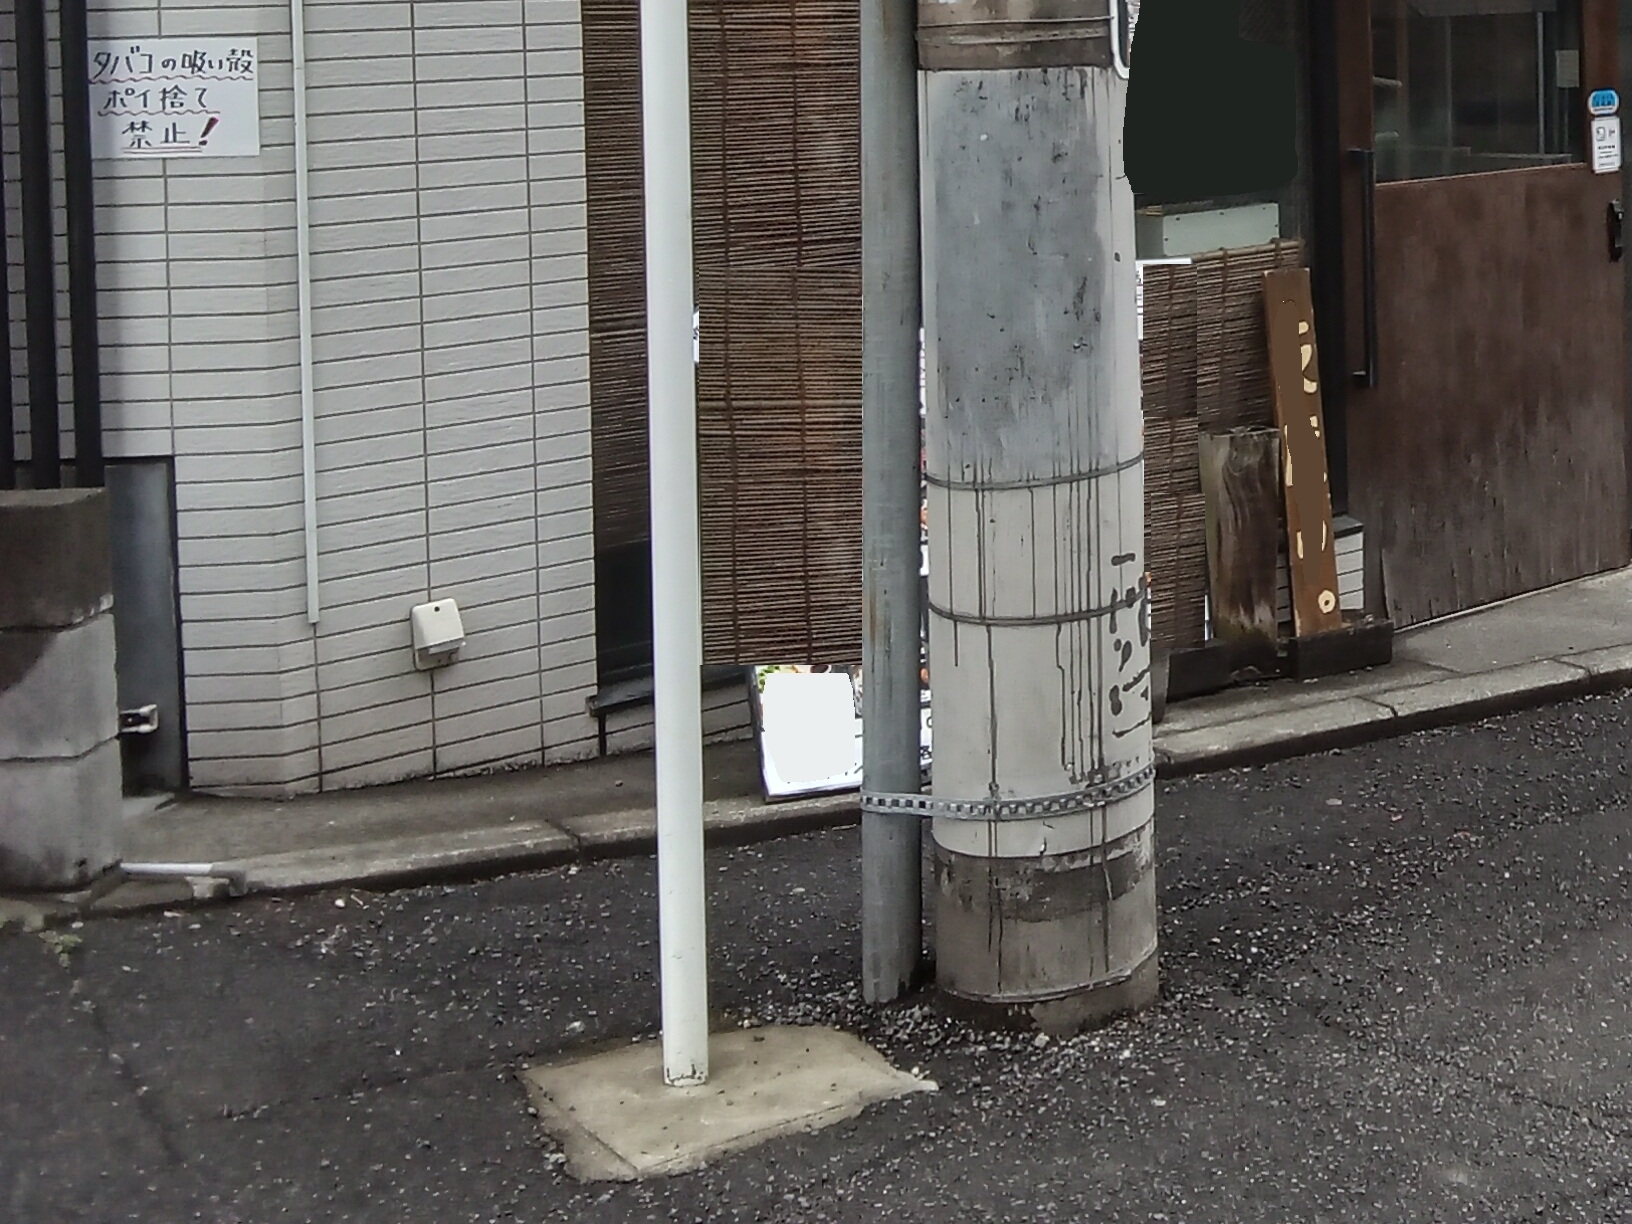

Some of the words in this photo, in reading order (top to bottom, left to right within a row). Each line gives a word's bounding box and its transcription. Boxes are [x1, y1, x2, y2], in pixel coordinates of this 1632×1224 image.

[93, 45, 254, 79] タバコの吸い殻
[103, 84, 209, 111] ポイ捨て
[121, 116, 219, 149] 禁止!
